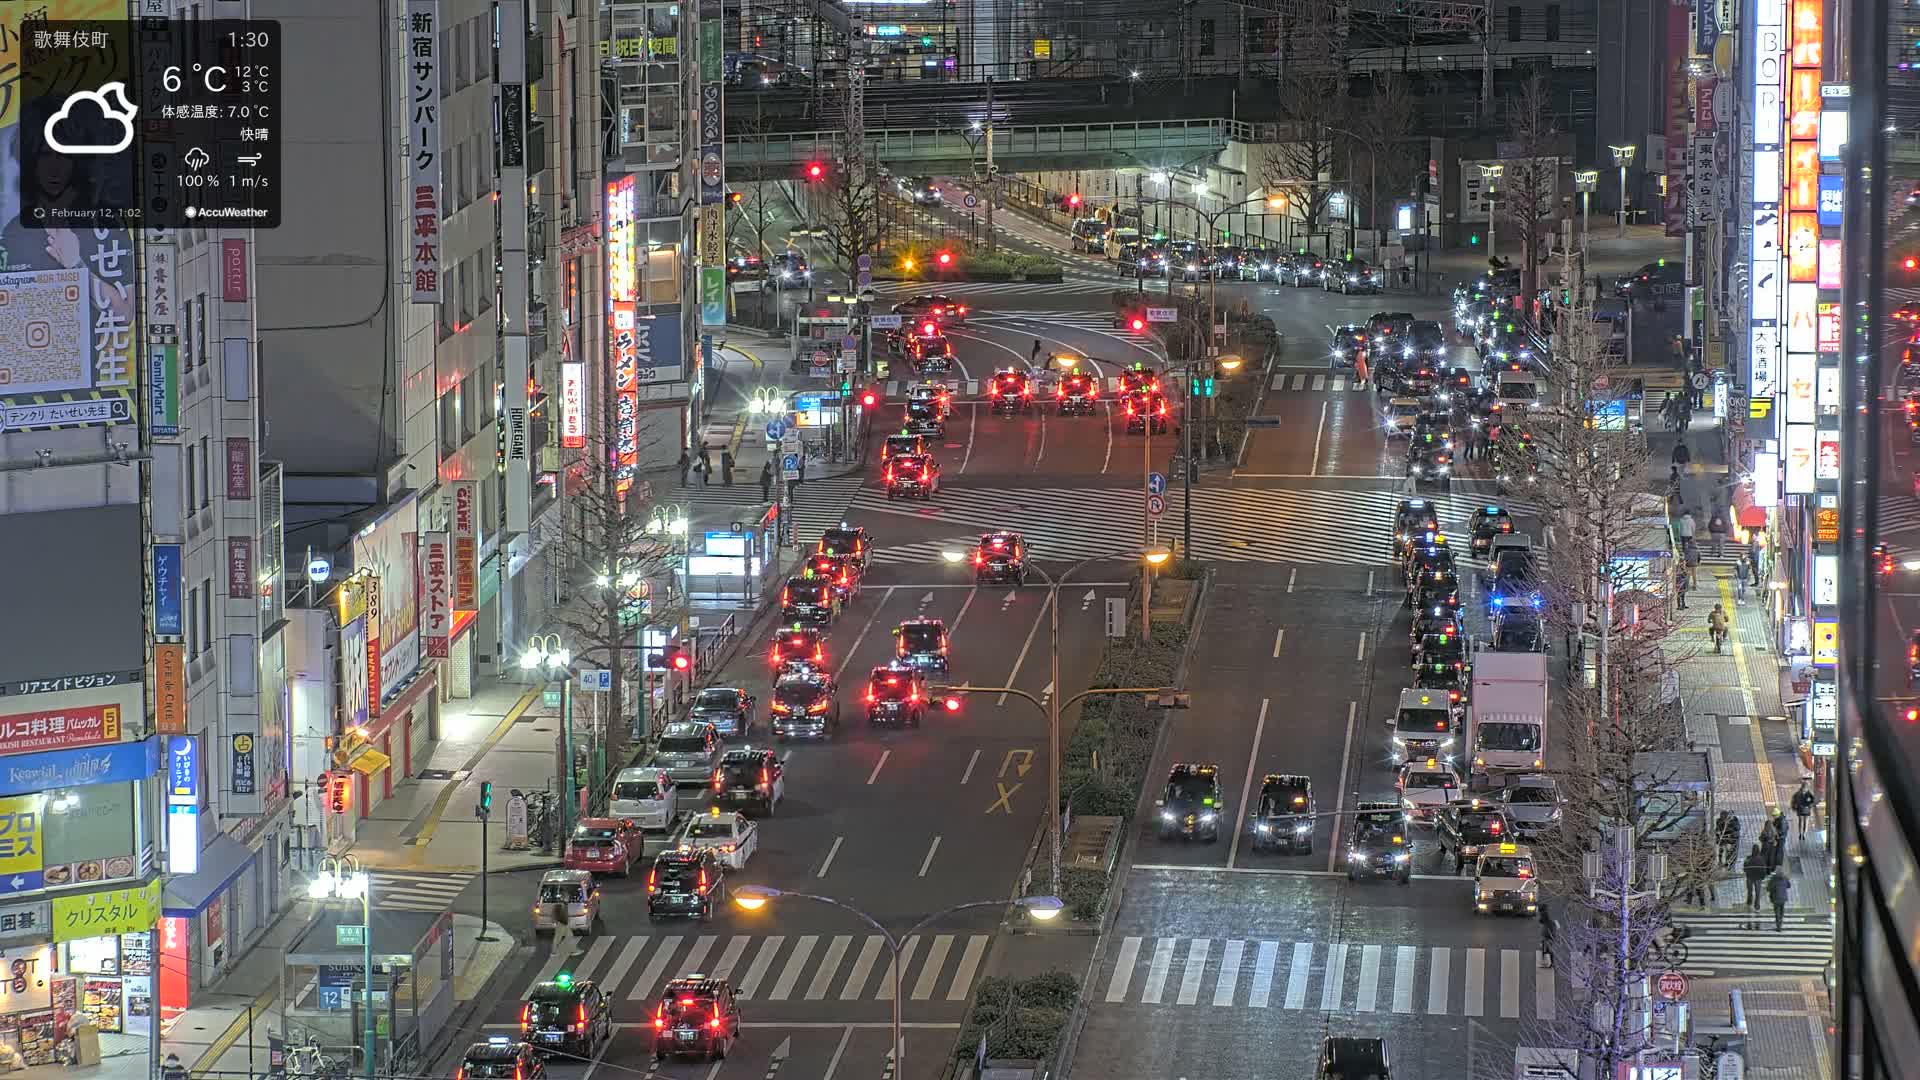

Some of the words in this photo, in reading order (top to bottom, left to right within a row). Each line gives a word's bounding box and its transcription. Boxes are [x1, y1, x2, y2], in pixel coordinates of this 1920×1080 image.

[412, 12, 435, 171] 新宿サンパーク
[1701, 88, 1712, 121] アコム
[415, 185, 437, 293] 三平本館
[707, 208, 719, 264] 肉汁水餃子
[153, 354, 165, 415] FamilyMart
[616, 333, 634, 389] ラーメン
[10, 410, 45, 423] テンクリ
[50, 405, 107, 420] たいせい先生
[510, 408, 525, 460] HOMEGAME
[457, 487, 469, 532] GAME
[158, 555, 168, 606] ゲウチャイ
[429, 543, 446, 630] 三平ストア
[1, 911, 35, 932] 囲碁
[66, 903, 138, 928] クリスタル
[322, 991, 338, 1005] 12
[1661, 979, 1683, 991] 消火栓
